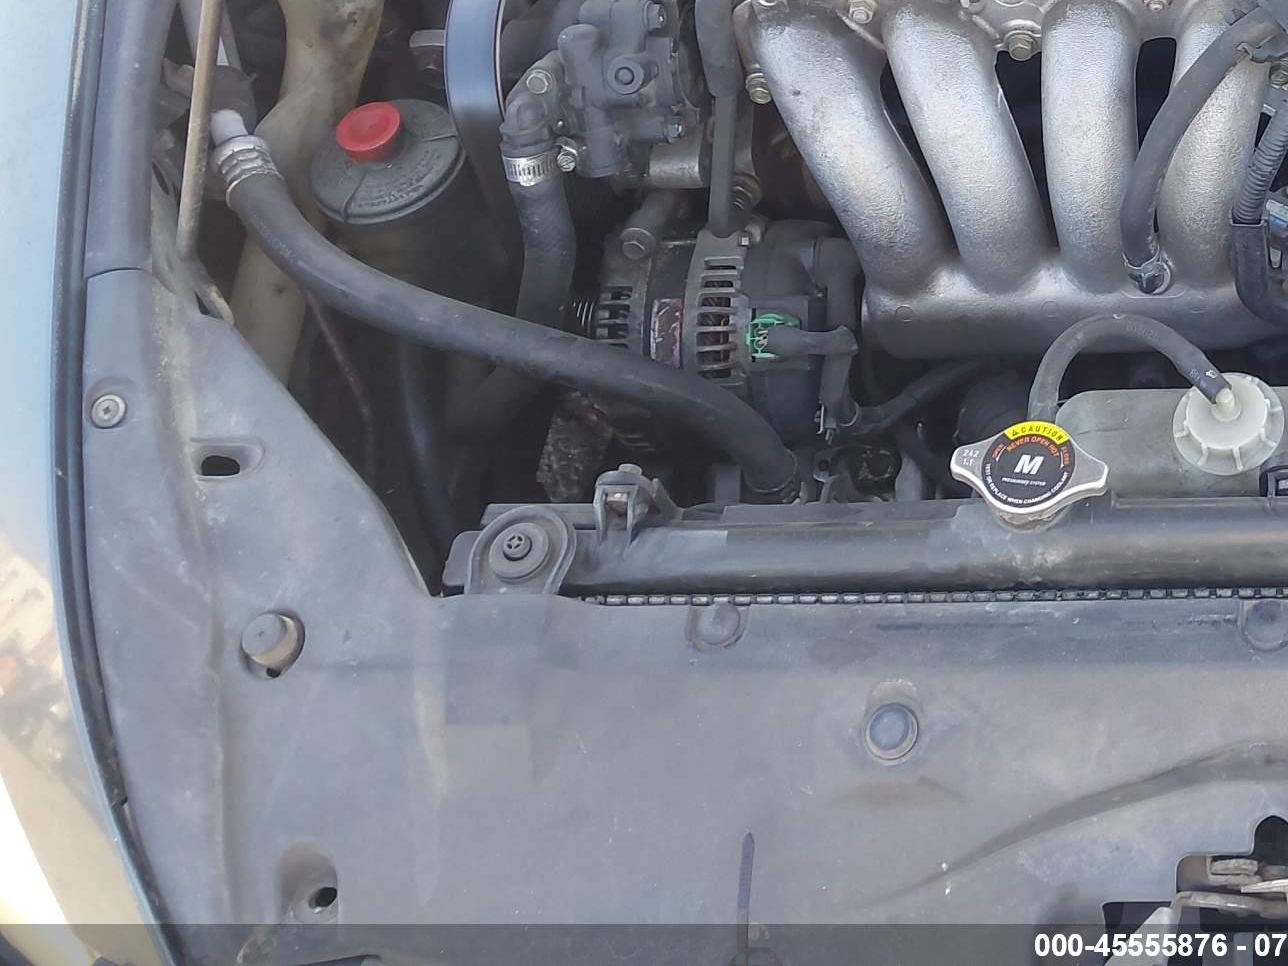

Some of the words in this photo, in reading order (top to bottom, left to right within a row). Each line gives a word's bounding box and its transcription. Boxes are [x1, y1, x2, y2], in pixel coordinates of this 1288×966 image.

[1020, 425, 1064, 441] CAUTION
[962, 449, 980, 458] 242
[1006, 436, 1031, 452] NEVER
[1031, 436, 1048, 446] OPEN
[1047, 444, 1060, 458] HOT
[1014, 454, 1045, 475] M
[989, 482, 1008, 500] REPLACE
[1007, 497, 1023, 505] WHEN
